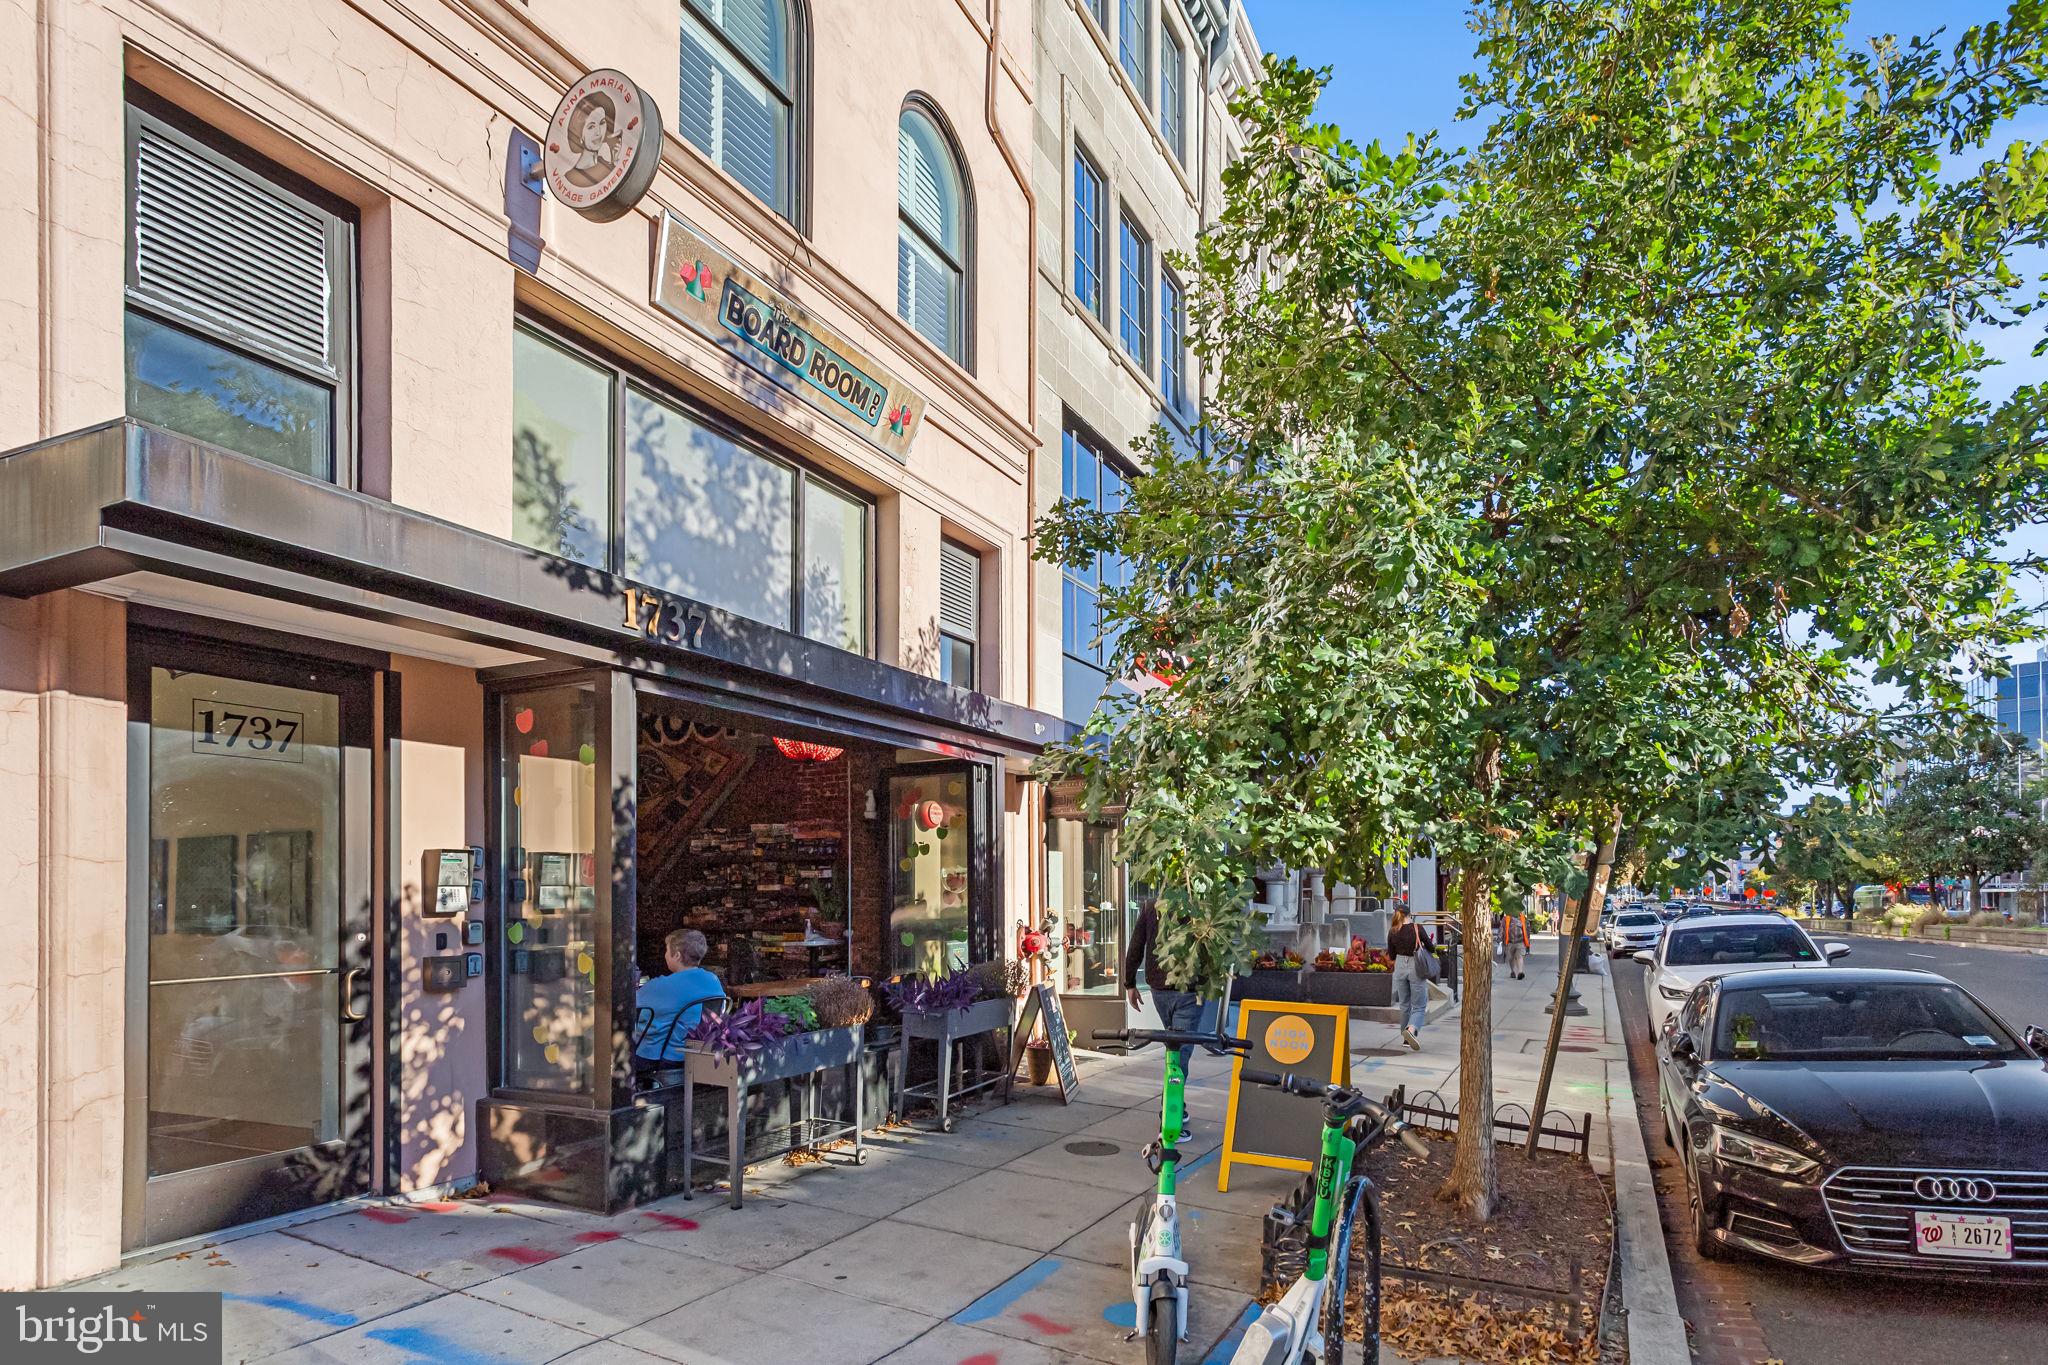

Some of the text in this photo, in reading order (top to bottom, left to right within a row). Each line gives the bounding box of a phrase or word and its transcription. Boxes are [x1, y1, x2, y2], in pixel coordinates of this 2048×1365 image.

[558, 79, 633, 127] ANNA MARIA'S
[552, 168, 584, 202] VINTAGE
[727, 293, 806, 366] BOARD
[808, 350, 871, 411] ROOM
[622, 588, 707, 649] 1737
[197, 709, 299, 754] 1737
[1964, 1228, 2002, 1246] 2672
